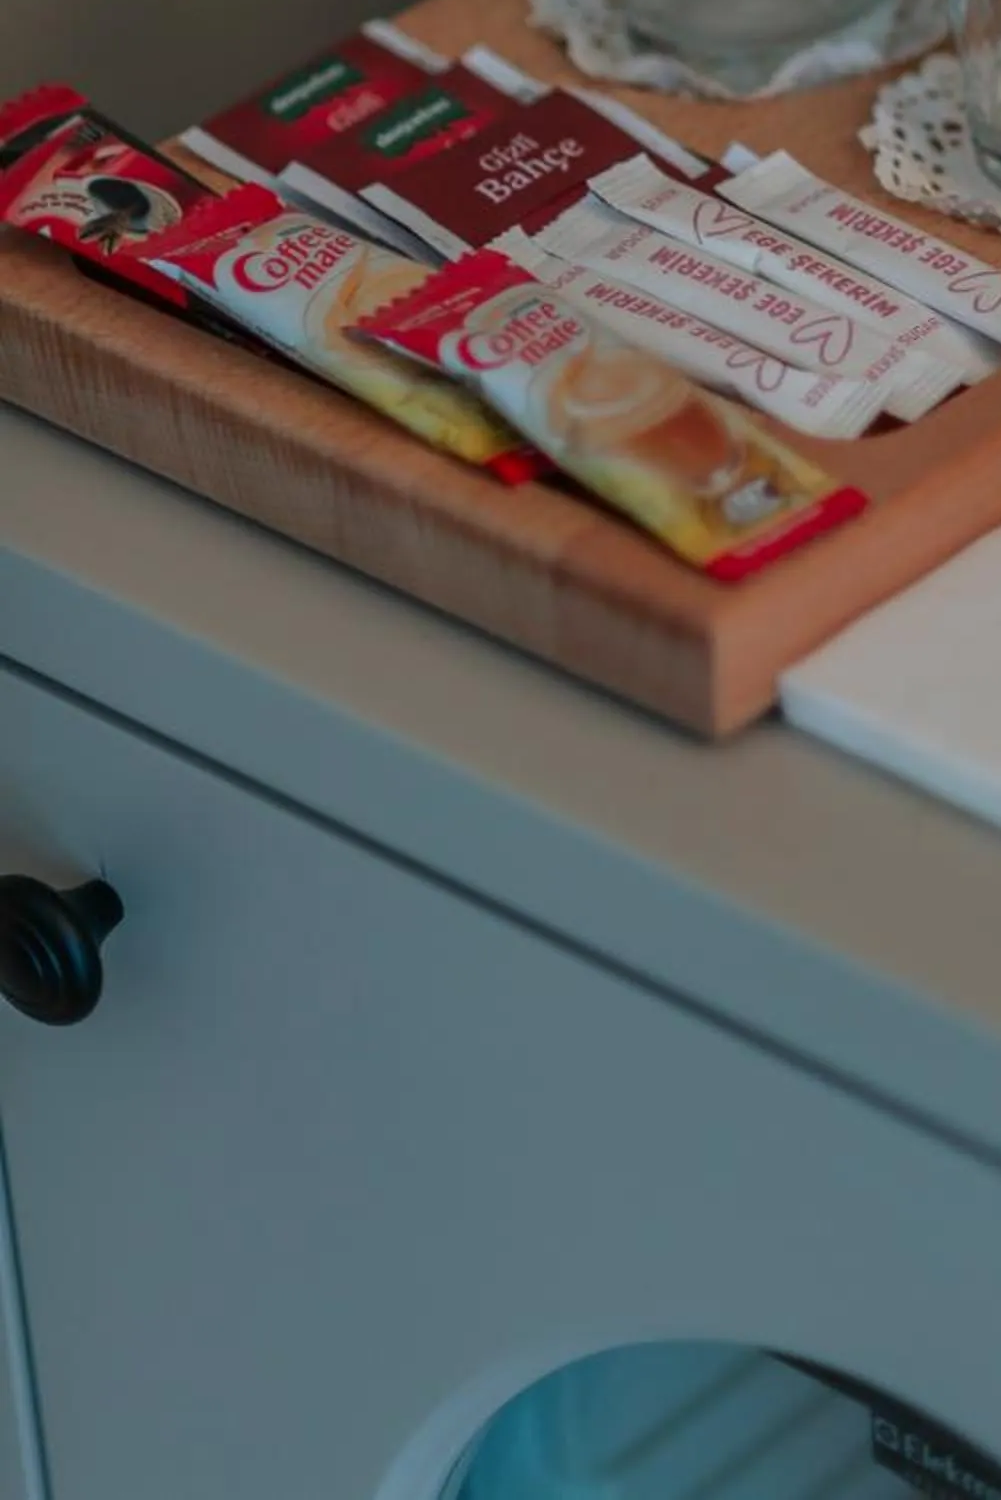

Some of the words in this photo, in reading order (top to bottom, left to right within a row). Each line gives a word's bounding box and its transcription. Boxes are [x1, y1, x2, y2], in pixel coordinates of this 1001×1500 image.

[475, 137, 584, 203] Bahçe
[233, 227, 333, 292] Coffee
[295, 234, 358, 290] mate
[648, 245, 762, 301] ŞEKERİM
[741, 230, 793, 256] EGE
[786, 254, 899, 318] ŞEKERİM
[918, 247, 969, 276] EGE
[457, 303, 561, 369] Coffee
[752, 293, 806, 325] EGE
[520, 319, 582, 367] mate
